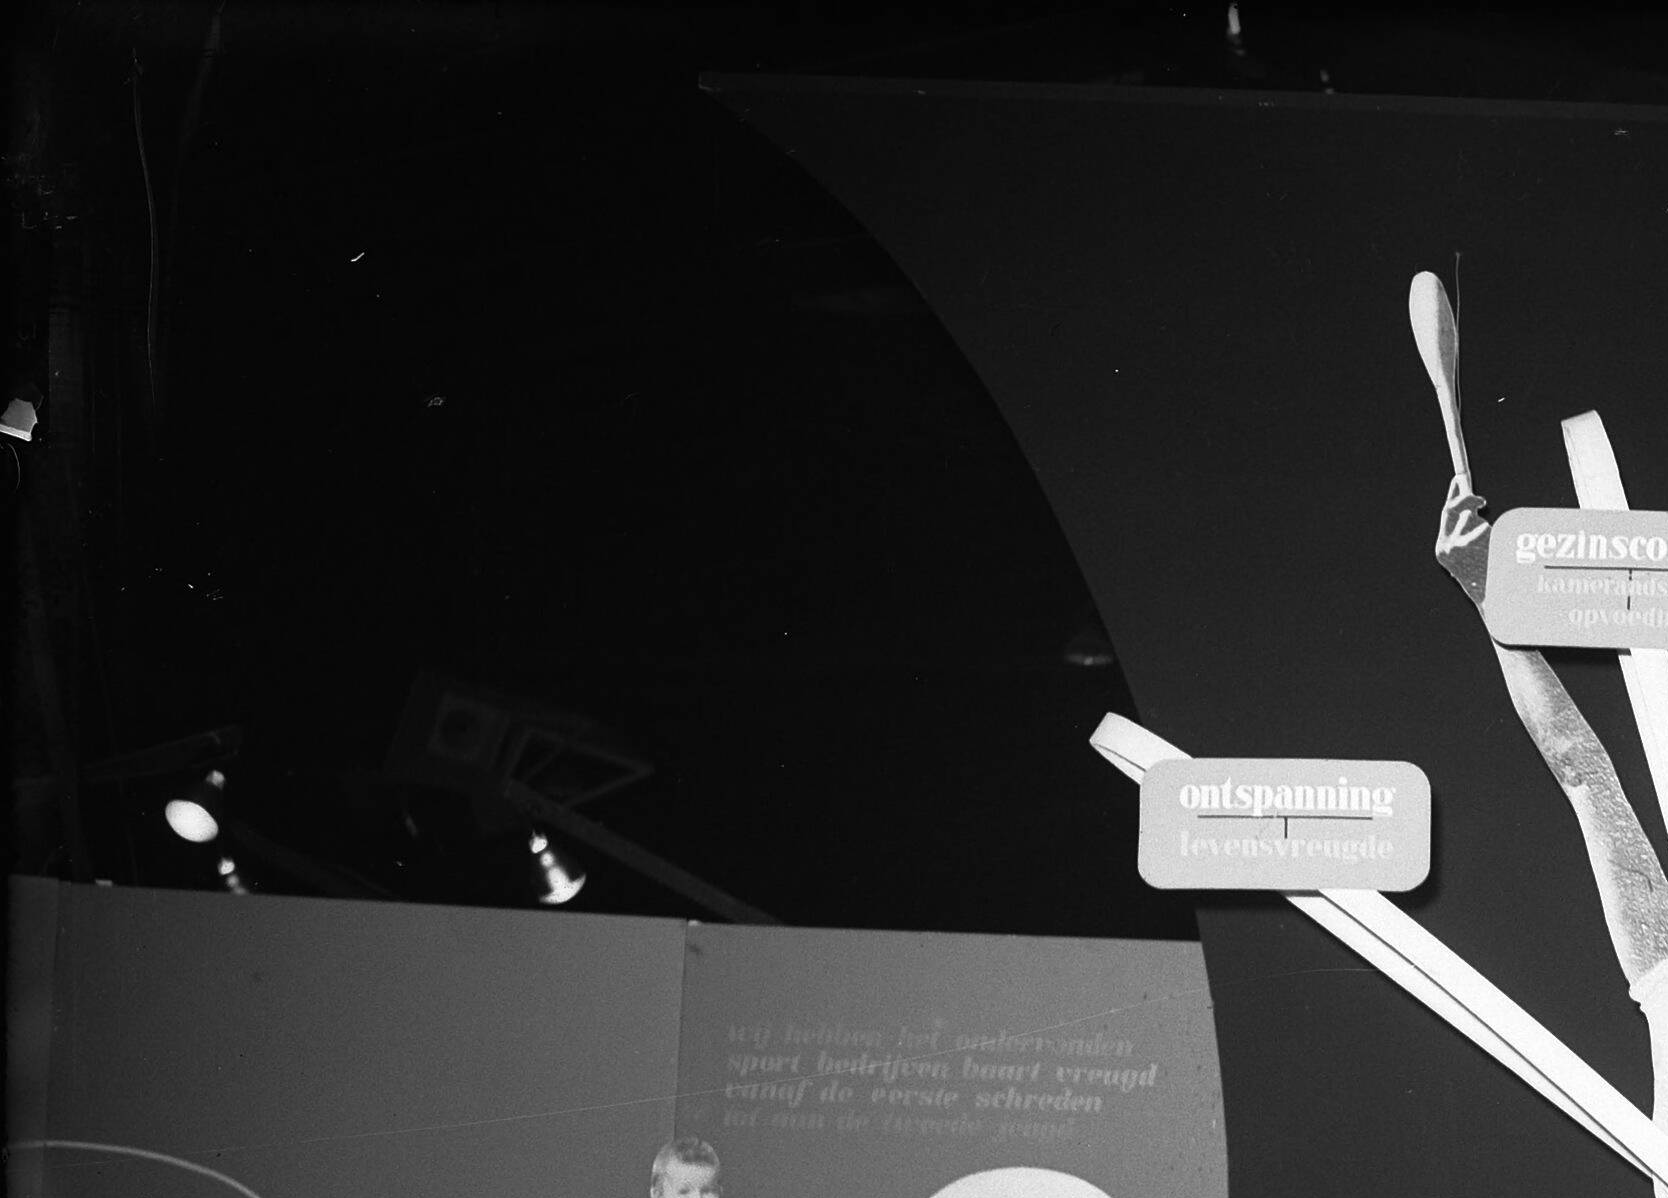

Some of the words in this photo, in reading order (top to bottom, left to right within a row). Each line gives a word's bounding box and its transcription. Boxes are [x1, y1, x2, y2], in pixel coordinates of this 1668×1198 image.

[1179, 776, 1397, 817] ontspanning
[1179, 830, 1395, 864] levensvreugde
[727, 1053, 802, 1077] sport
[816, 1050, 951, 1083] bedrijven
[961, 1056, 1042, 1081] baart
[1055, 1062, 1159, 1093] vreugd
[819, 1079, 855, 1103] de
[870, 1086, 960, 1110] eerste
[974, 1086, 1103, 1113] schreden
